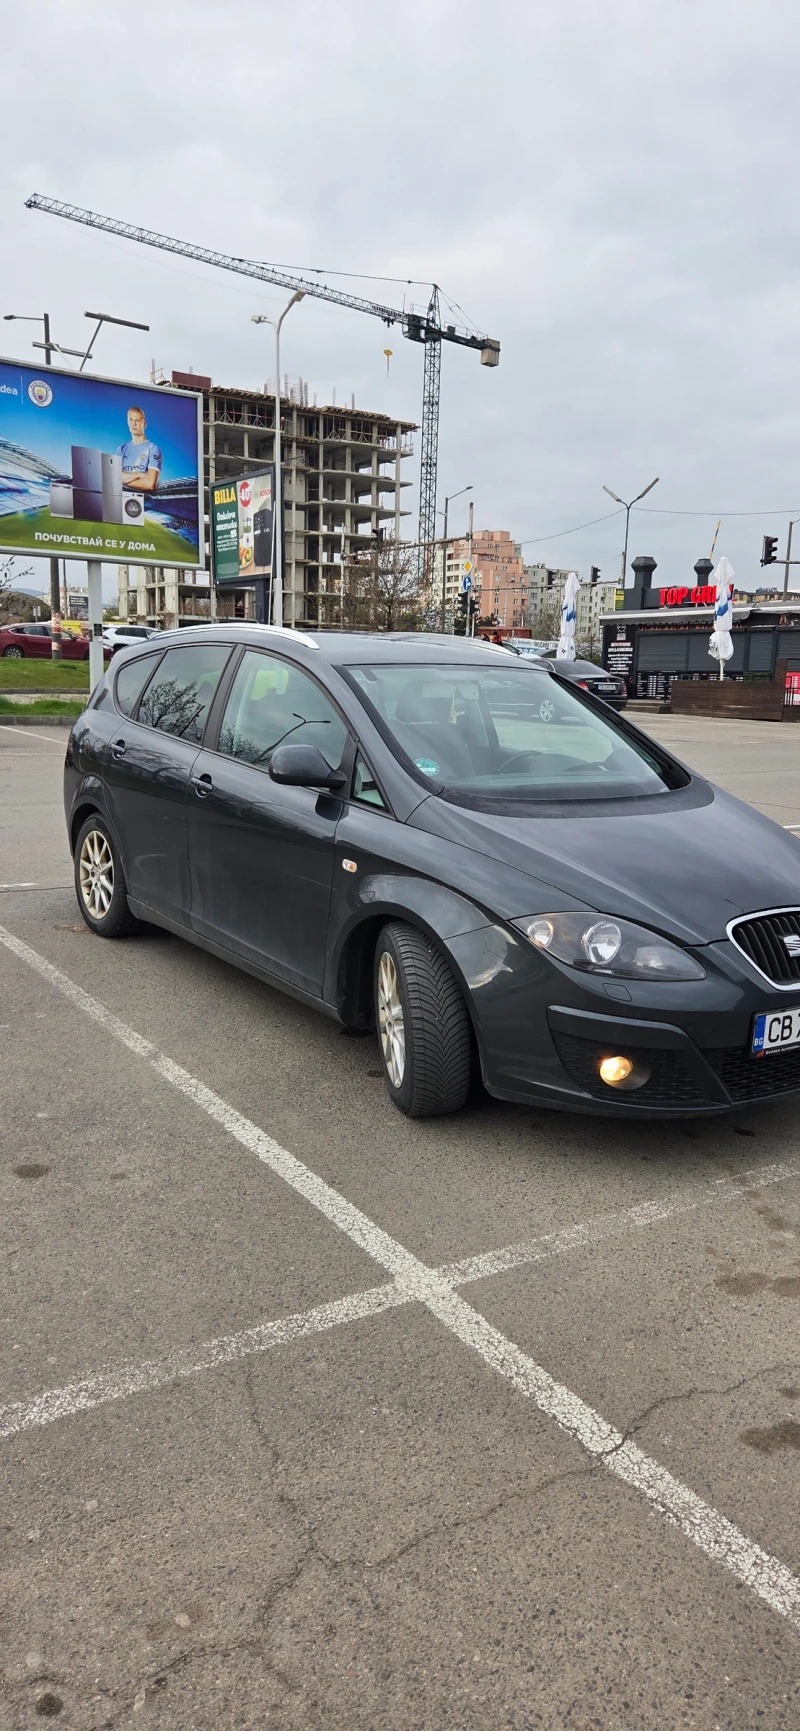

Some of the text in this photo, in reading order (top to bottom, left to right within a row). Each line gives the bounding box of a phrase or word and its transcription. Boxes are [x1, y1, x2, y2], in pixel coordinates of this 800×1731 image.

[214, 487, 236, 505] BILLA
[34, 532, 103, 547] ПОЧУВСТВАЙ
[105, 539, 117, 548] СЕ
[128, 541, 156, 551] ДОМА
[659, 584, 737, 606] TOP GRI
[768, 1015, 792, 1043] CB
[754, 1037, 763, 1047] BG
